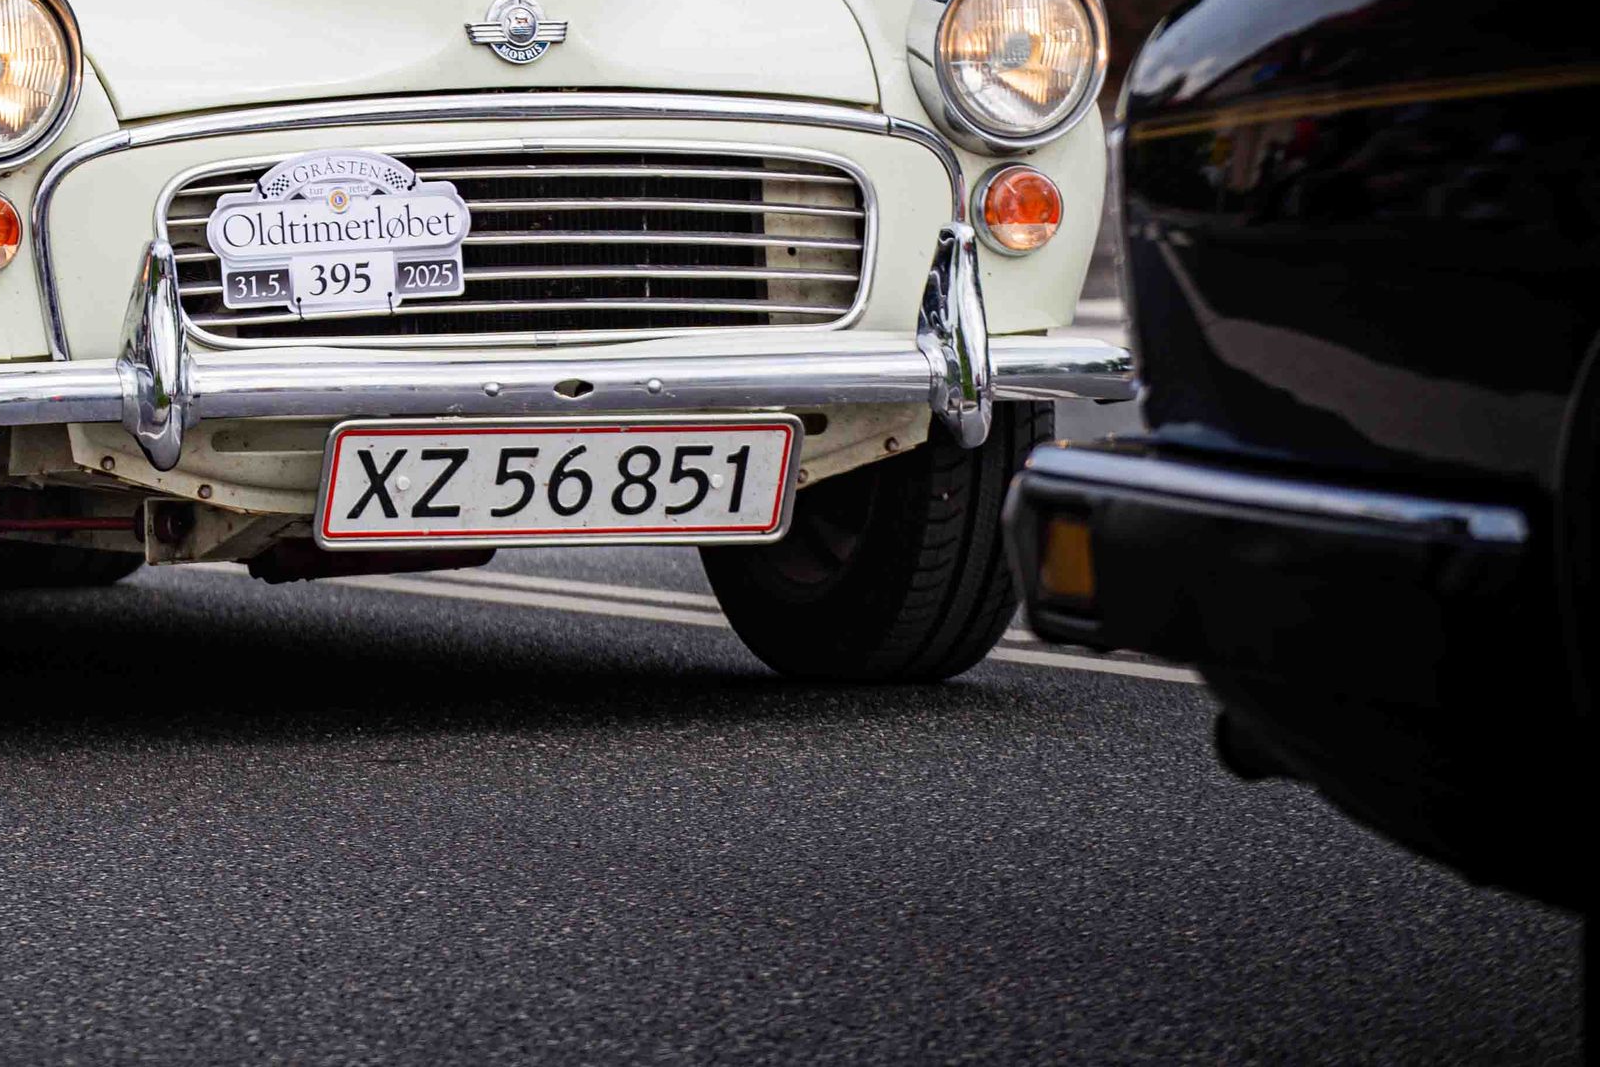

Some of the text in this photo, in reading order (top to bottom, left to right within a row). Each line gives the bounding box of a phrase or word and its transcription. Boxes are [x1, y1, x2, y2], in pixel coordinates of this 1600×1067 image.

[500, 44, 542, 61] MORRIS
[292, 156, 382, 184] GRÅSTEN
[223, 204, 456, 248] Oldtimerløbet
[234, 273, 287, 299] 31.5.
[308, 261, 372, 296] 395
[403, 264, 453, 289] 2025
[346, 444, 750, 519] XZ 56 851
